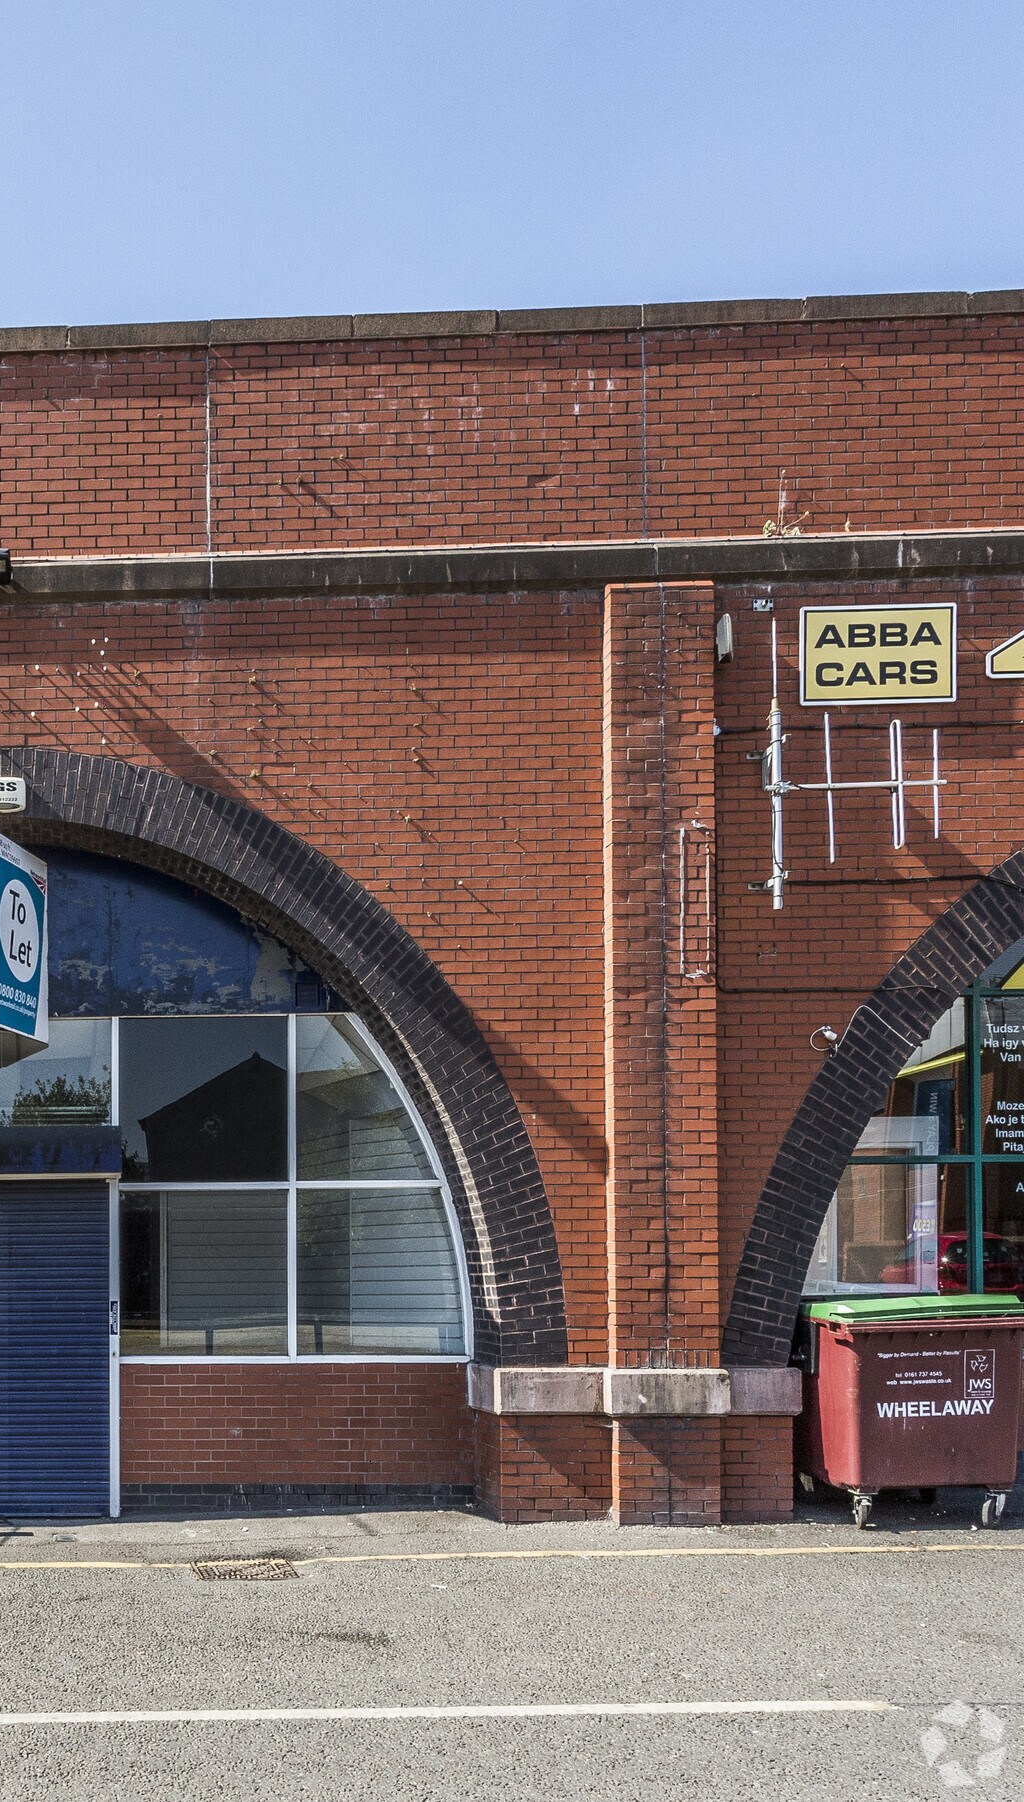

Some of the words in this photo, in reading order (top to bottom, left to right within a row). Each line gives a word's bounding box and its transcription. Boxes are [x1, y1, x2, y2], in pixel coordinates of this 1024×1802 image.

[814, 622, 942, 648] ABBA
[815, 660, 938, 687] CARS
[10, 889, 26, 924] To
[10, 930, 32, 967] Let
[14, 989, 26, 1004] 830
[26, 994, 36, 1008] 840
[986, 1024, 1019, 1033] Tudsz
[984, 1038, 999, 1047] Ha
[1003, 1038, 1019, 1049] igy
[1000, 1052, 1021, 1062] Van
[985, 1115, 1006, 1124] Ako
[1007, 1115, 1018, 1126] je
[1003, 1142, 1024, 1153] Pita
[967, 1379, 991, 1392] JWS
[877, 1399, 994, 1418] WHEELAWAY
